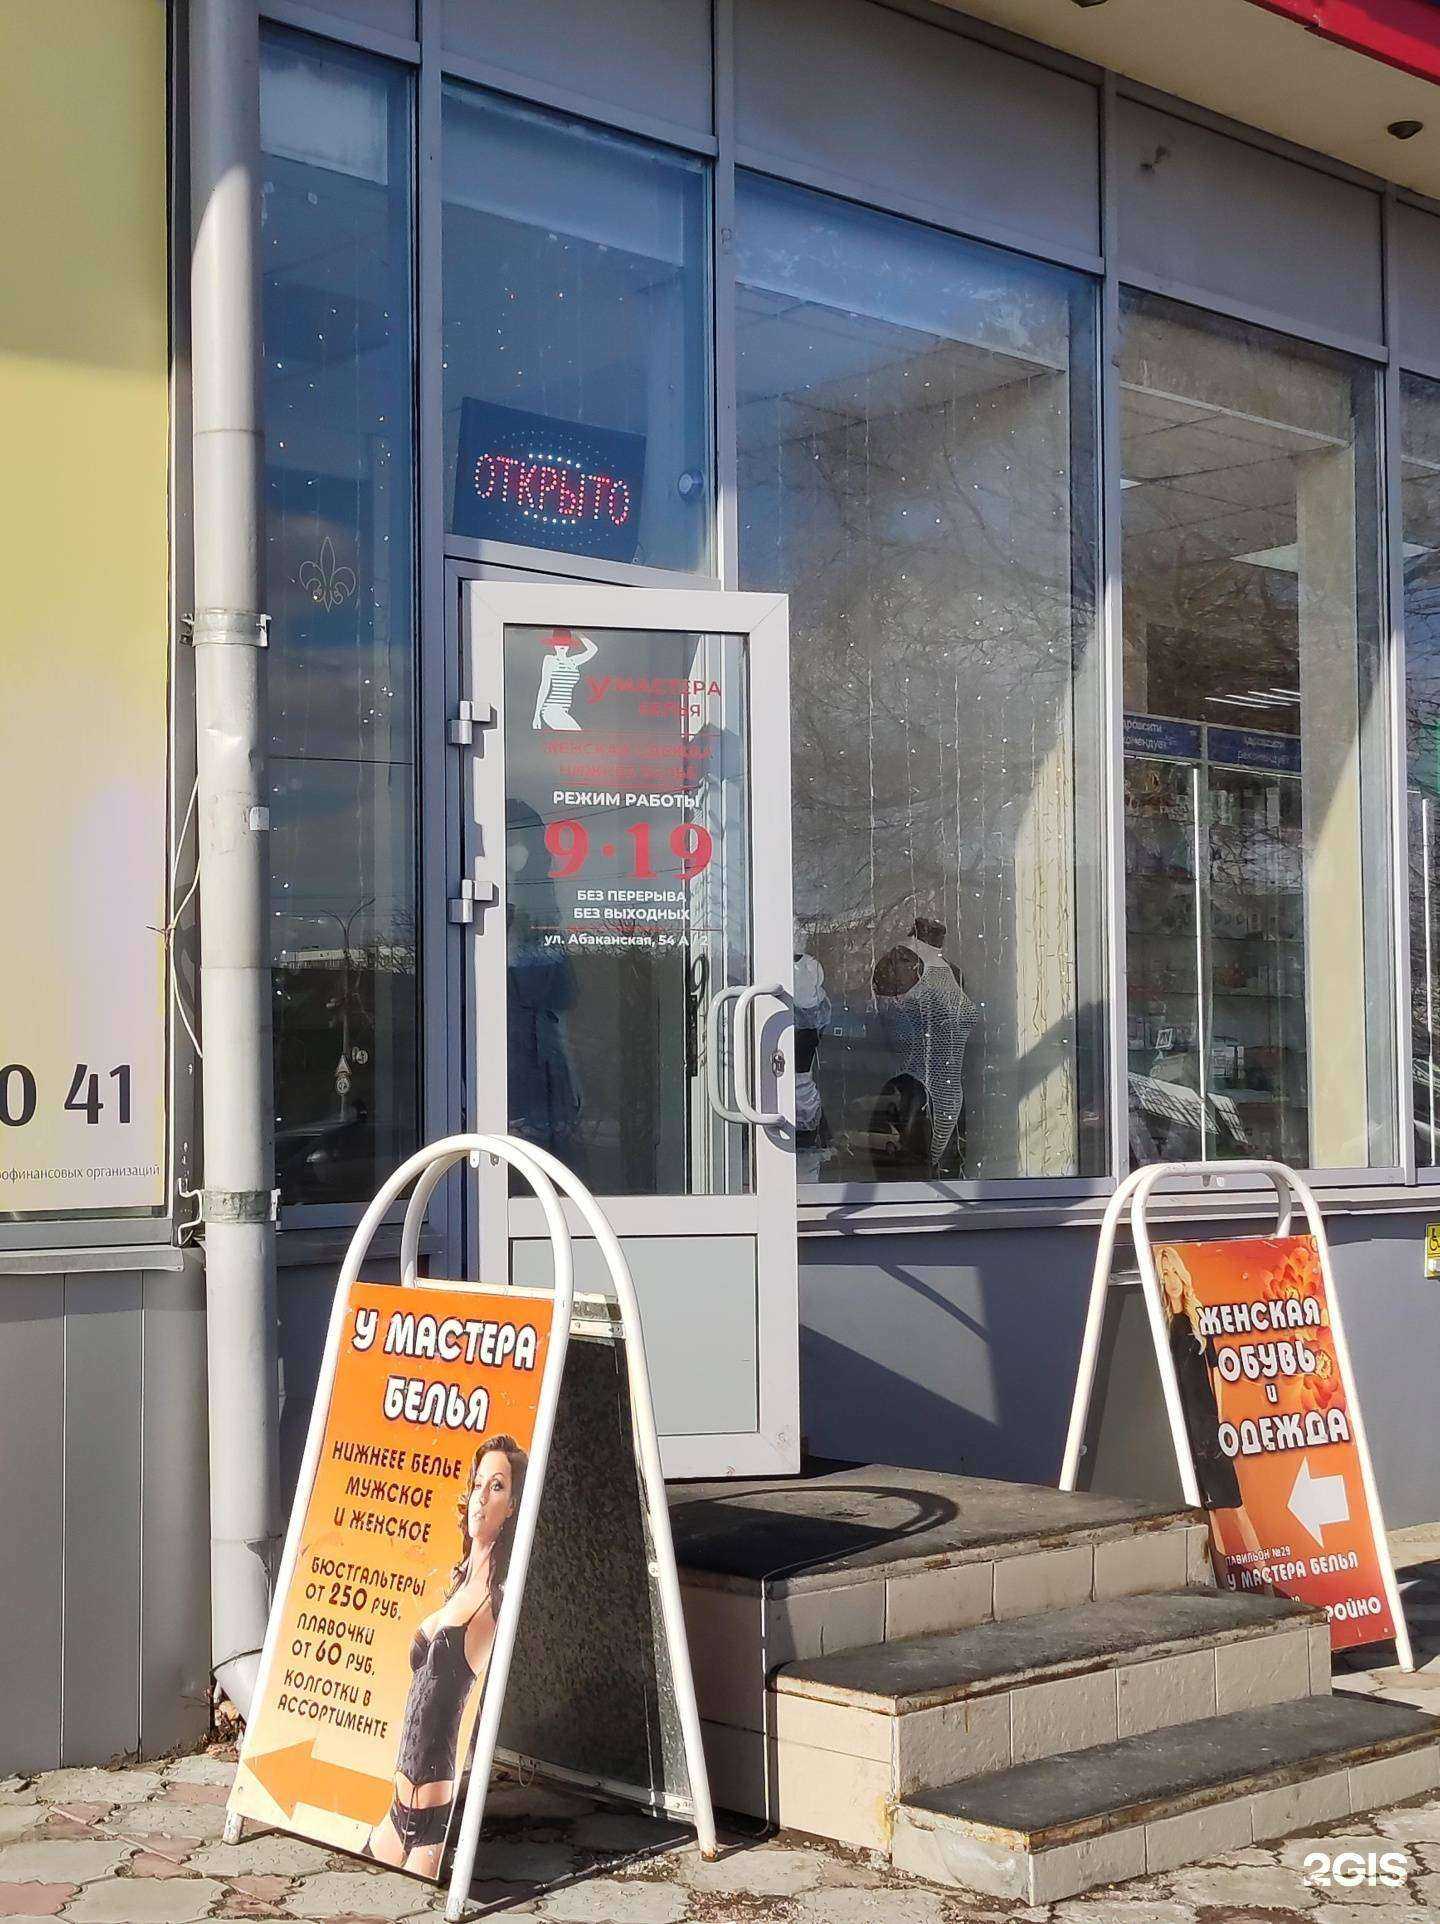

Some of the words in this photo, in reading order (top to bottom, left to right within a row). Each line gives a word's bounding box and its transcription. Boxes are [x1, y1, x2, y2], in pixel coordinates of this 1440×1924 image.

[474, 453, 630, 527] ОТКРЫТО
[553, 790, 620, 807] РЕЖИМ
[625, 793, 700, 809] РАБОТЫ
[577, 890, 604, 901] БЕЗ
[607, 890, 687, 903] ПЕРЕРЫВА
[573, 907, 600, 919] БЕЗ
[604, 908, 690, 922] ВЫХОДНЫХ
[544, 935, 565, 946] ул.
[568, 933, 655, 949] Абаканская,
[658, 935, 676, 946] 54
[64, 1064, 131, 1125] 41
[0, 1168, 83, 1183] офинансовых
[86, 1164, 160, 1182] организаций
[1196, 1297, 1322, 1336] ЖЕНСКАЯ
[352, 1308, 379, 1351] У
[384, 1311, 537, 1370] МАСТЕРА
[1217, 1340, 1318, 1383] ОБУВЬ
[383, 1375, 490, 1433] БЕЛЬЯ
[1217, 1408, 1351, 1458] ОДЕЖДА
[410, 1452, 463, 1480] БЕЛЬЕ
[345, 1475, 434, 1509] МУЖСКОЕ
[349, 1509, 432, 1543] ЖЕНСКОЕ
[311, 1556, 427, 1597] БЮСТГАЛЬТЕРЫ
[1226, 1573, 1237, 1591] У
[1241, 1560, 1306, 1589] МАСТЕРА
[1309, 1551, 1359, 1576] БЕЛЬЯ
[305, 1582, 326, 1602] ОТ
[328, 1582, 368, 1611] 250
[1323, 1595, 1382, 1623] РОЙНО
[297, 1613, 375, 1646] ПЛАВОЧКИ
[291, 1639, 312, 1659] ОТ
[315, 1640, 342, 1666] 60
[283, 1669, 360, 1704] КОЛГОТКИ
[362, 1690, 372, 1707] В
[277, 1694, 388, 1739] АССОРТИМЕНТЕ
